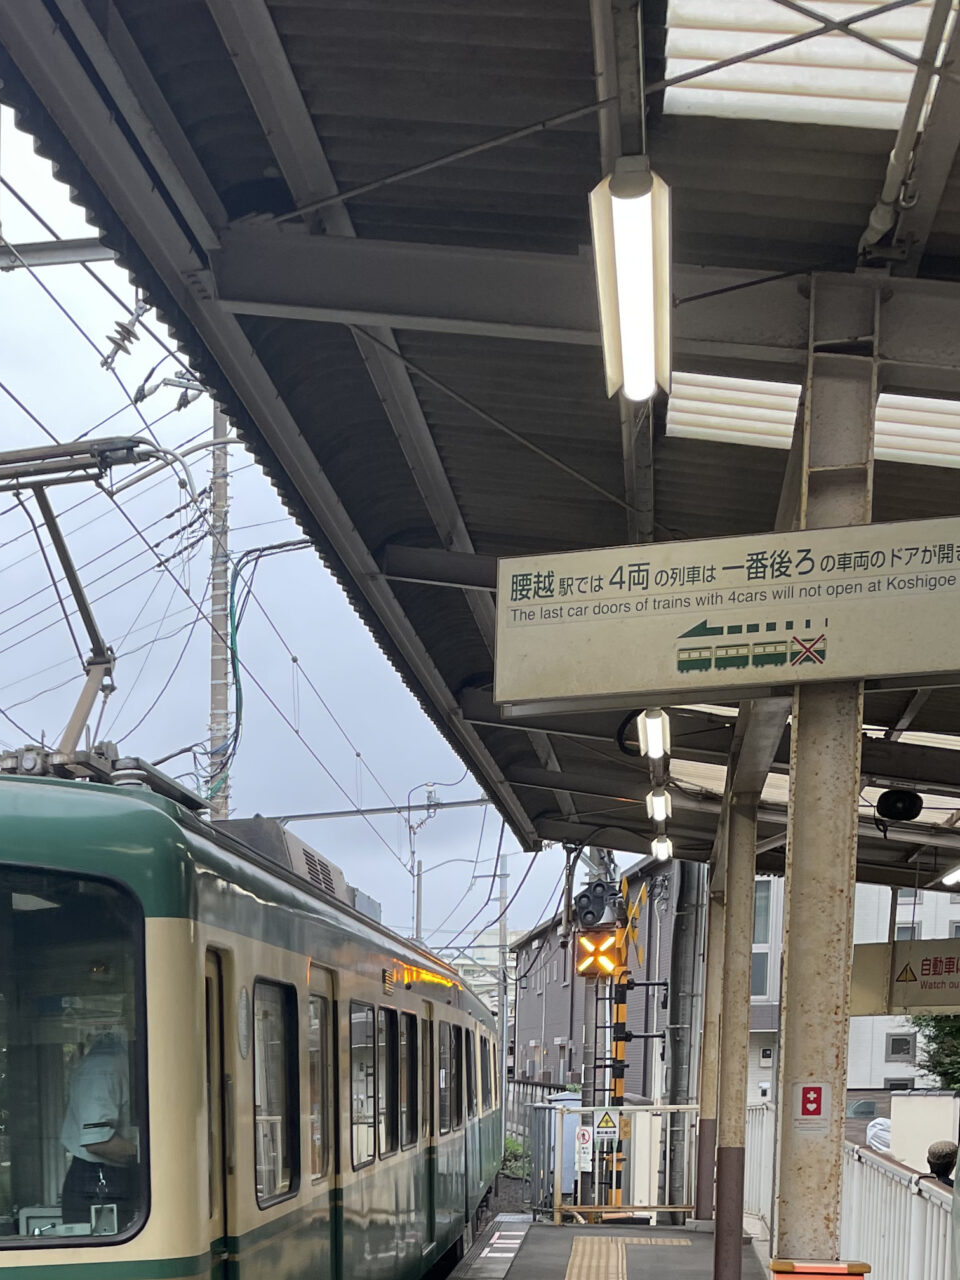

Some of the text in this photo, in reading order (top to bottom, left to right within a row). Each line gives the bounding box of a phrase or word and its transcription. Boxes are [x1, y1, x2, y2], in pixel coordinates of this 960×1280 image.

[511, 573, 957, 622] The last car doors of trains with 4cars will not open at Koshigoe
[920, 980, 947, 990] Watch
